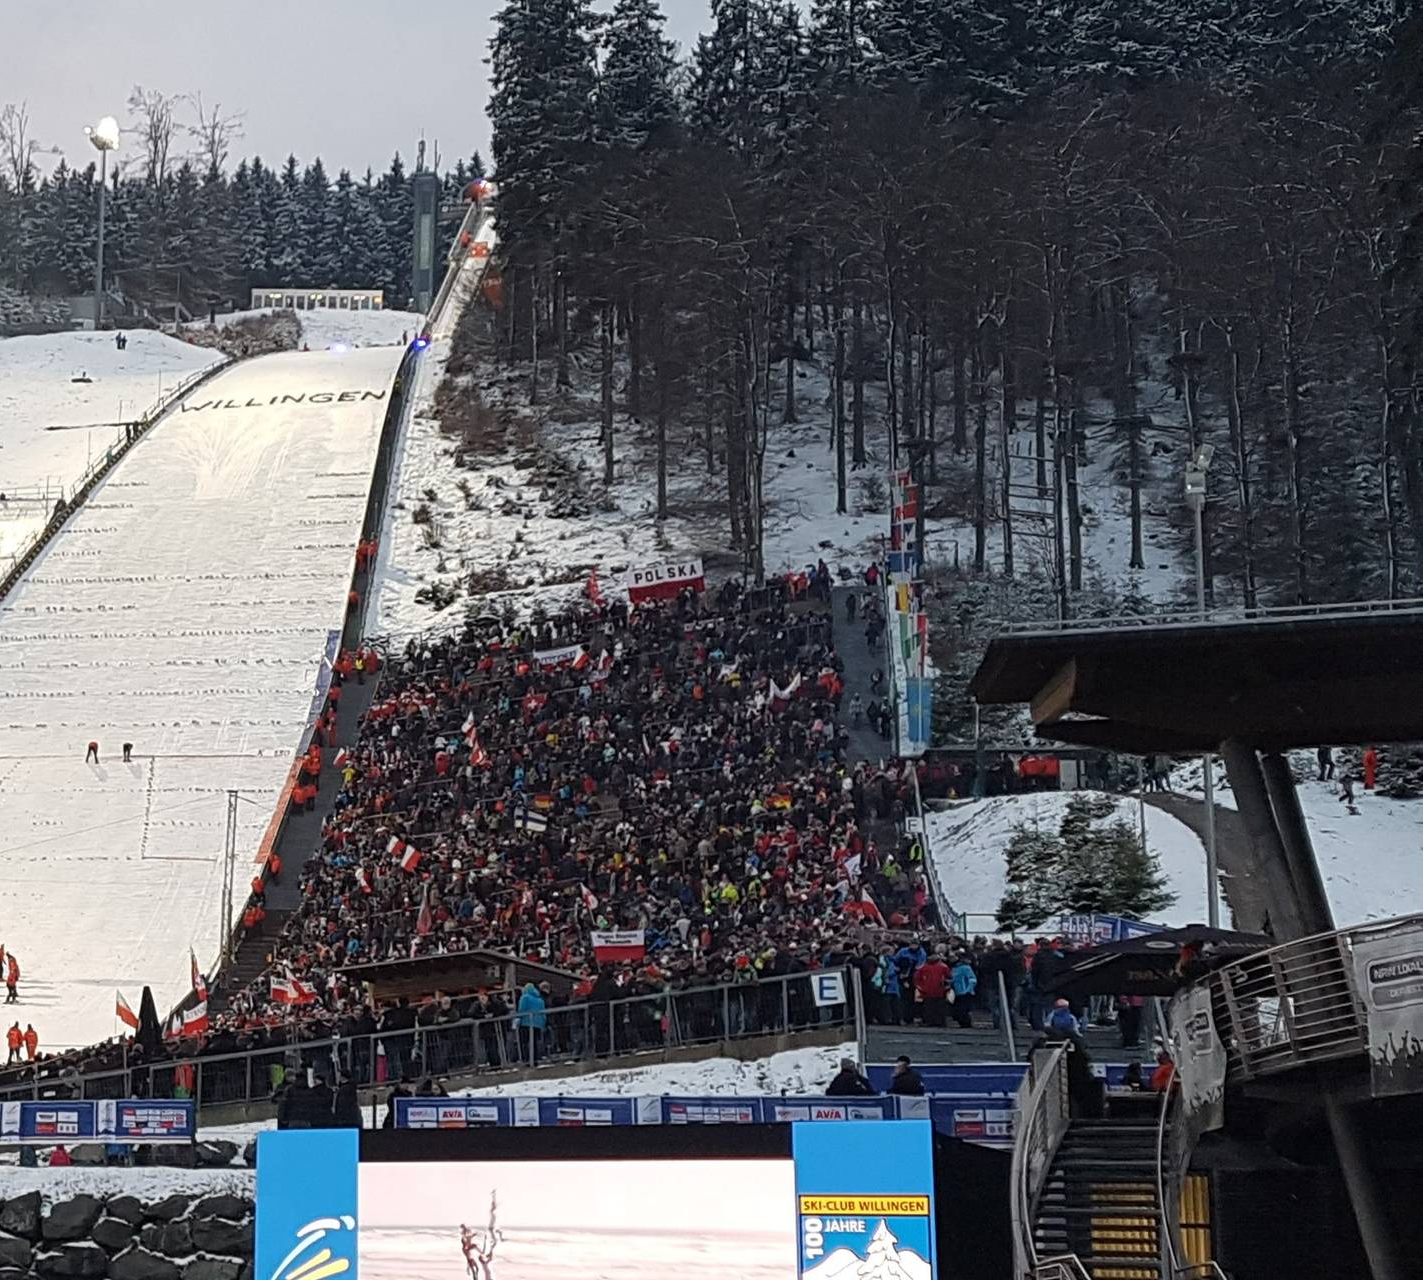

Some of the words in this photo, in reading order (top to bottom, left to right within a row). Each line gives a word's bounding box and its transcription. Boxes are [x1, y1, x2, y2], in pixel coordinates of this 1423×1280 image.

[180, 390, 386, 413] WILLINGEN
[634, 564, 697, 584] POLSKA
[818, 976, 839, 1000] E
[816, 1109, 842, 1119] AVIA
[804, 1201, 855, 1211] SKI-CLUB
[859, 1201, 924, 1211] WILLINGEN
[824, 1219, 866, 1232] JAHRE
[805, 1218, 824, 1260] 100
